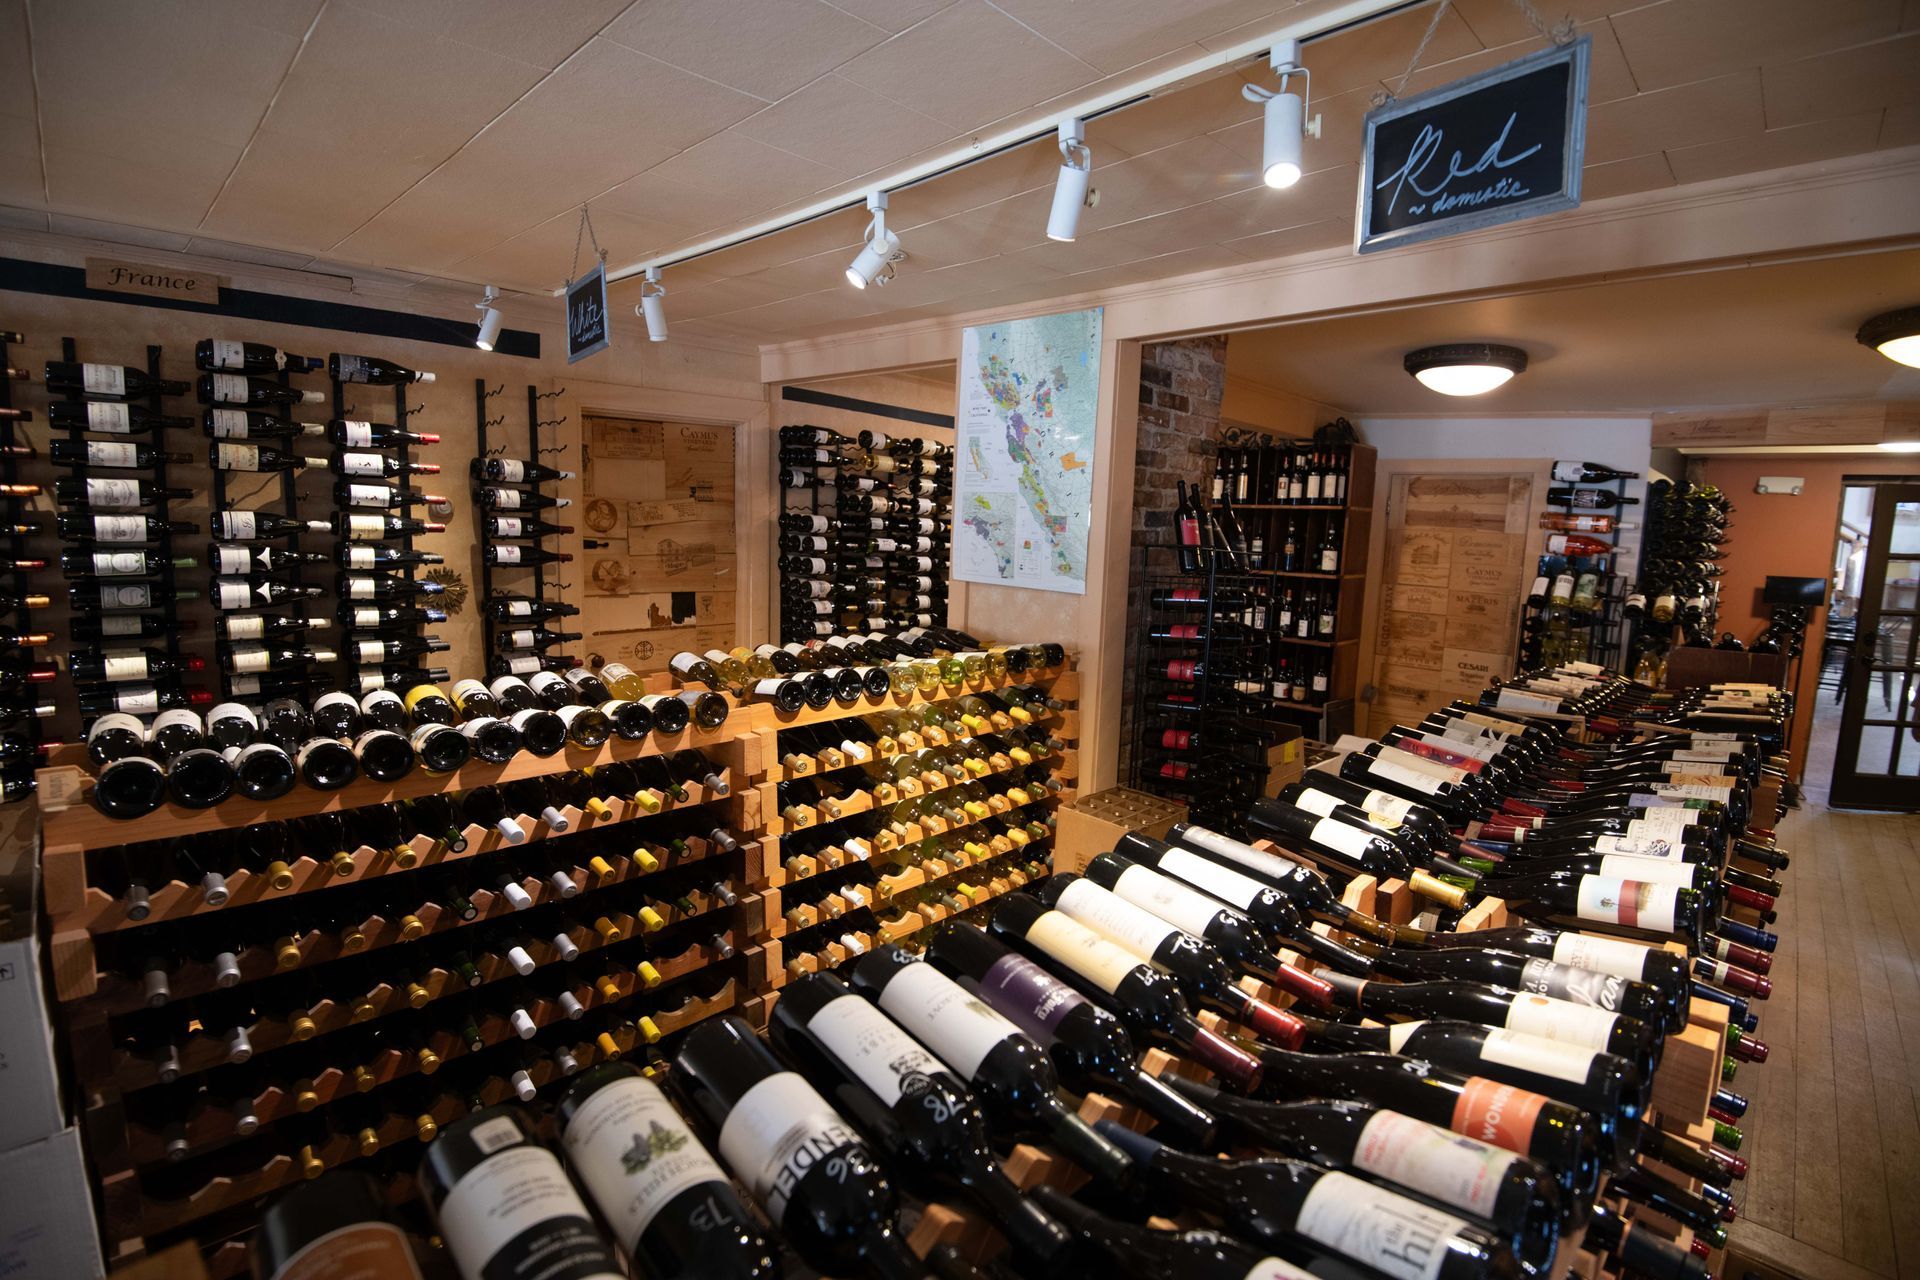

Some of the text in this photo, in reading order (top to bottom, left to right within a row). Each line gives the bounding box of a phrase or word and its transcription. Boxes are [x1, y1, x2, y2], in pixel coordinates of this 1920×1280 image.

[1376, 112, 1542, 216] Red
[1432, 178, 1529, 214] domestic
[107, 267, 196, 291] France
[680, 427, 719, 440] CAYMUS
[1457, 661, 1489, 673] CESARI
[1261, 889, 1280, 906] 50
